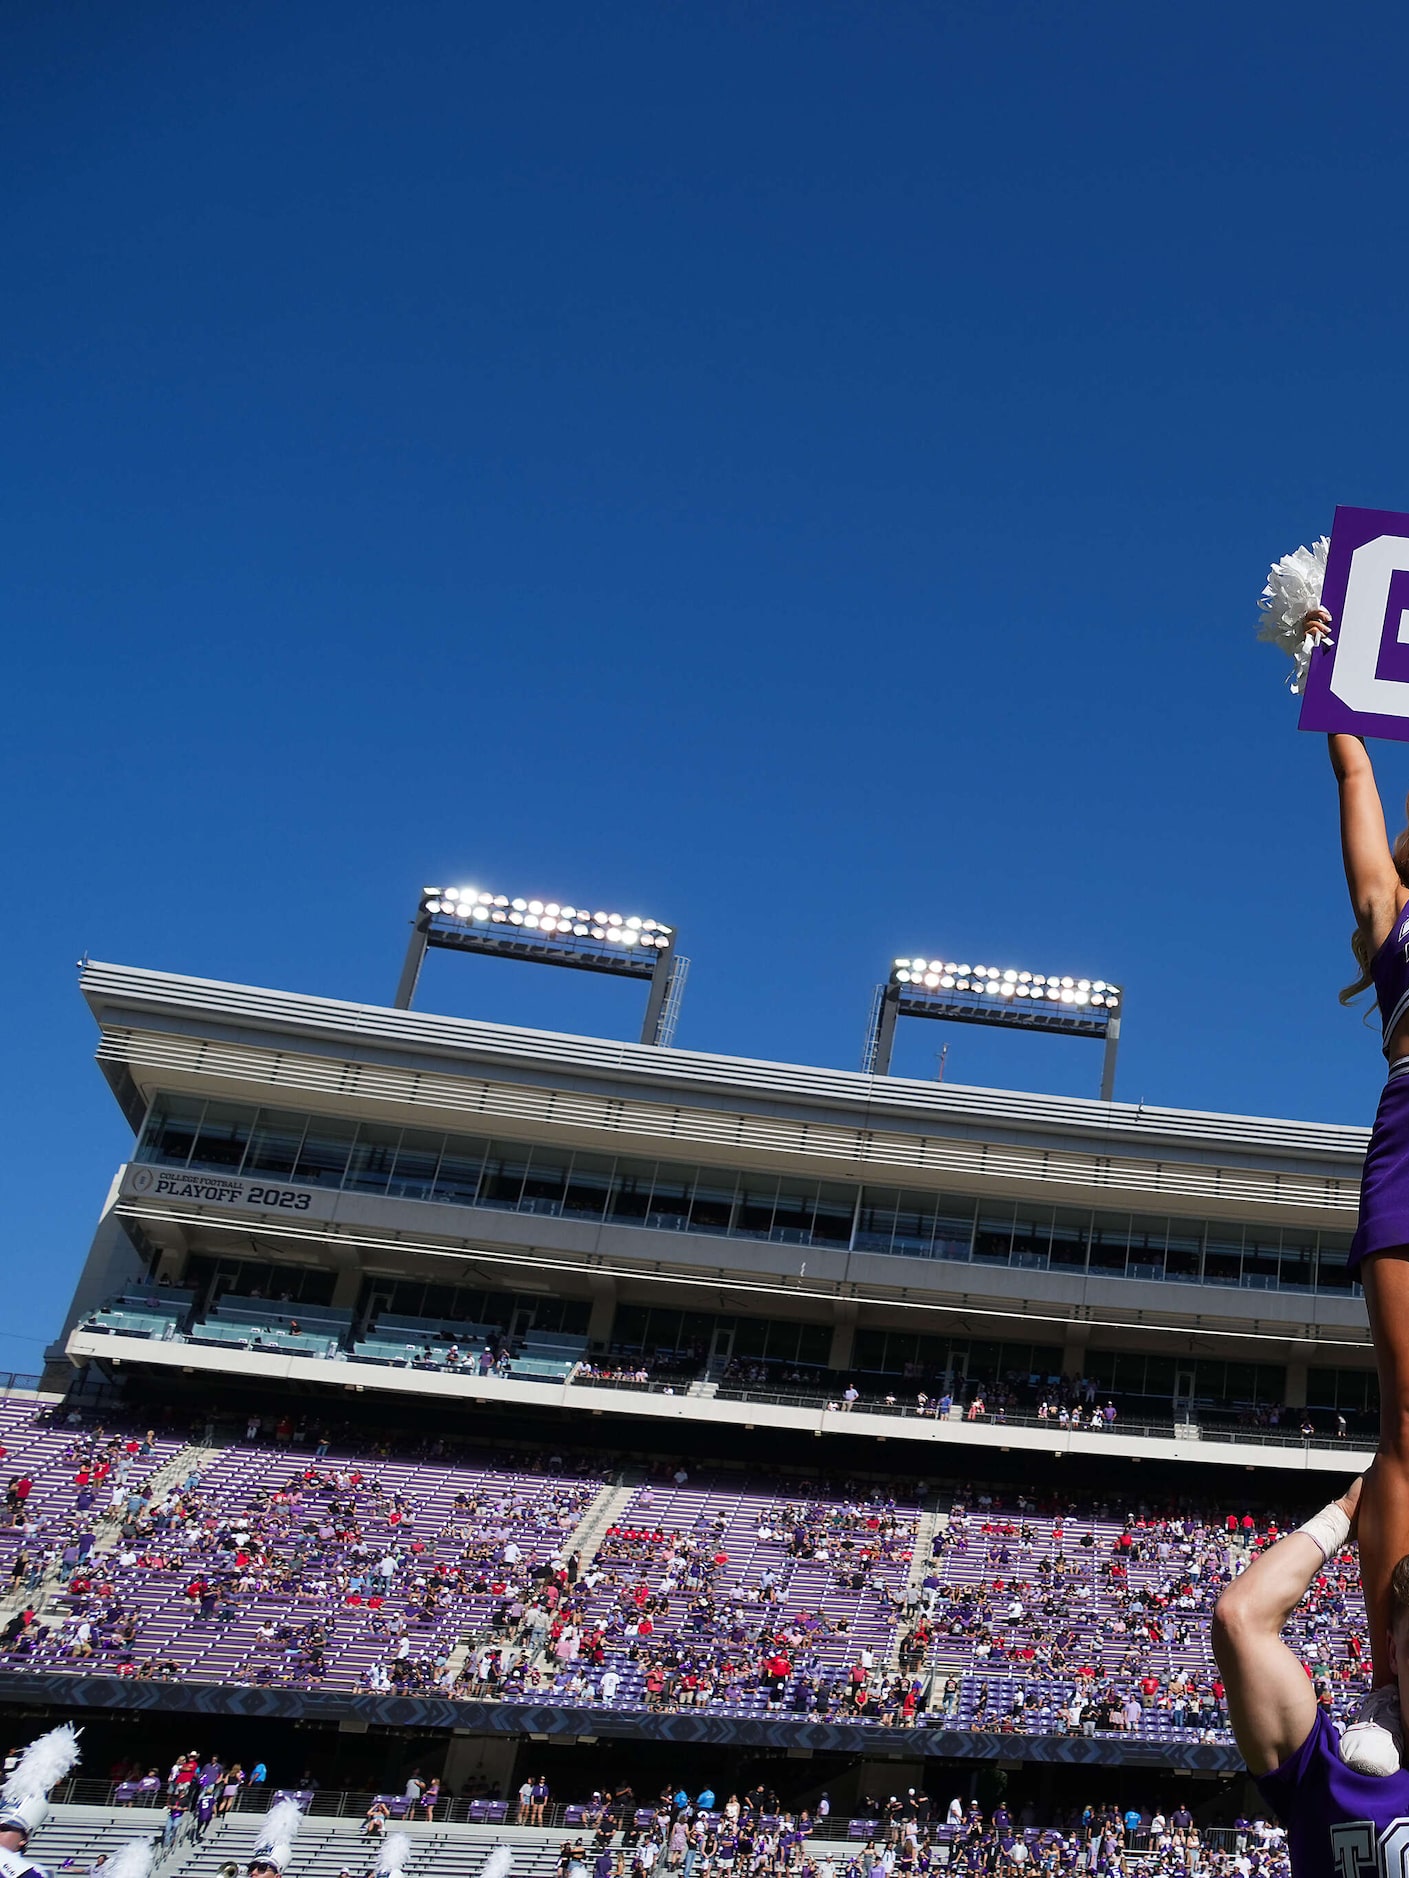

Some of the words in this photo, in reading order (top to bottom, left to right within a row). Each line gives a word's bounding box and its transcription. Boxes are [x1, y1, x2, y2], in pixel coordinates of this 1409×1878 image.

[159, 1172, 200, 1184] COLLEGE
[200, 1177, 244, 1190] FOOTBALL
[155, 1180, 243, 1203] PLAYOFF
[247, 1187, 312, 1210] 2023
[201, 1799, 209, 1809] 5
